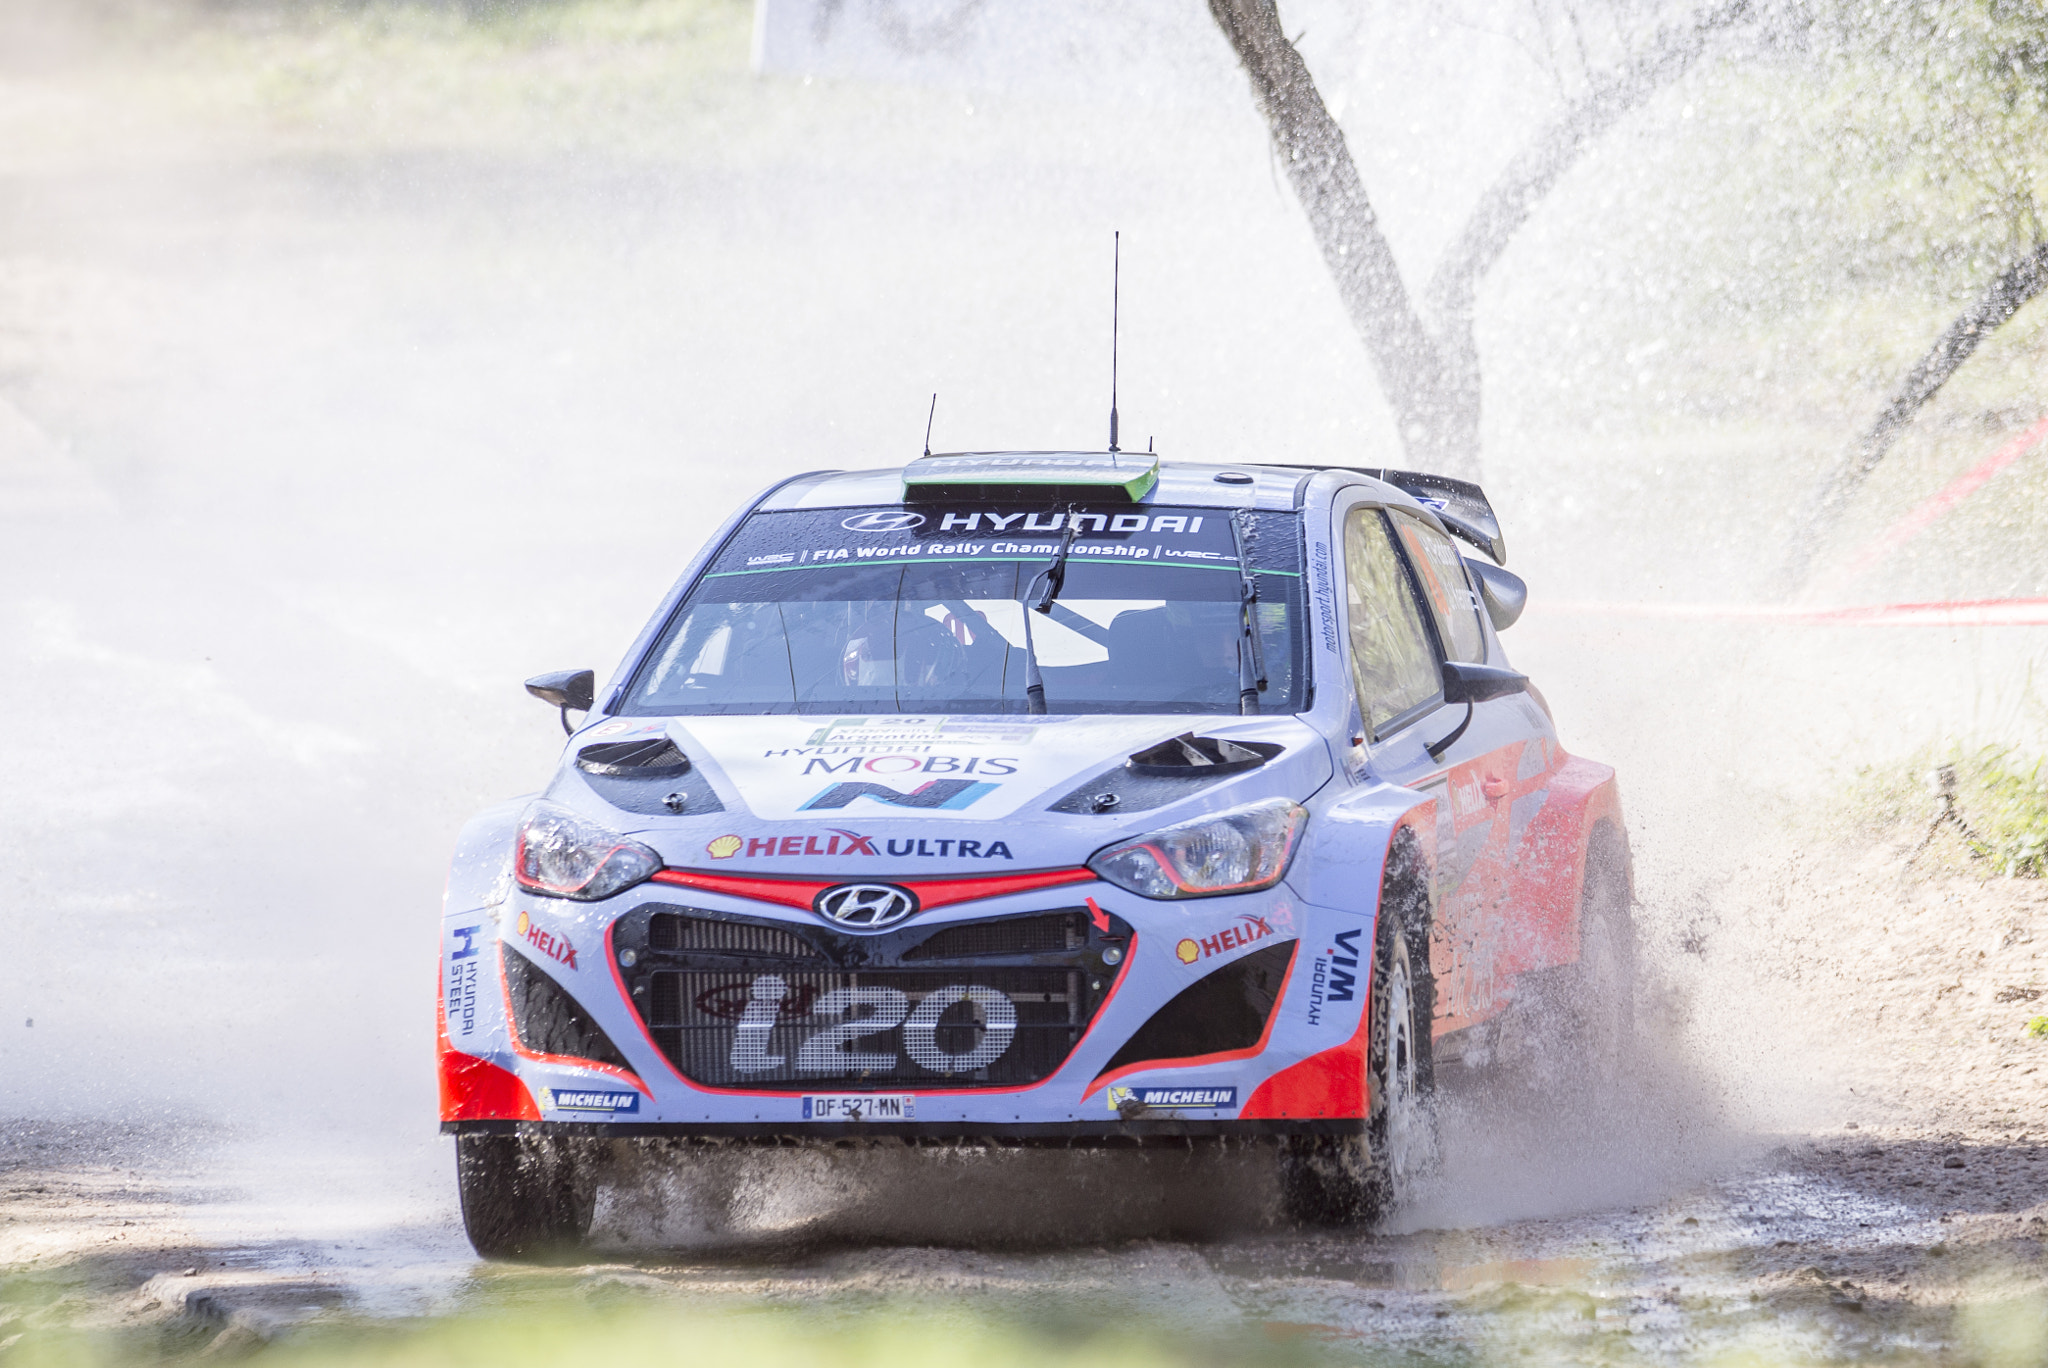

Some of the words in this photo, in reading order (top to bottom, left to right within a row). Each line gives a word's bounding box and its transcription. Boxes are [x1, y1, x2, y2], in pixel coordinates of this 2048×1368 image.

[940, 513, 1203, 533] HYUNDAI
[812, 549, 850, 560] FIA
[857, 544, 922, 558] World
[927, 543, 985, 555] Rally
[1312, 541, 1337, 654] motorsport.hyundai.com
[764, 746, 931, 758] HYUNDAI
[802, 755, 1019, 775] MOBIS
[745, 828, 880, 857] HELIX
[886, 838, 1014, 860] ULTRA
[526, 924, 578, 971] HELIX
[1200, 914, 1274, 957] HELIX
[448, 964, 463, 1018] STEEL
[461, 961, 478, 1036] HYUNDAI
[1307, 957, 1328, 1026] HYUNDAI
[558, 1093, 633, 1108] MICHELIN
[816, 1098, 900, 1117] DF-527-MN
[1144, 1091, 1232, 1104] MICHELIN
